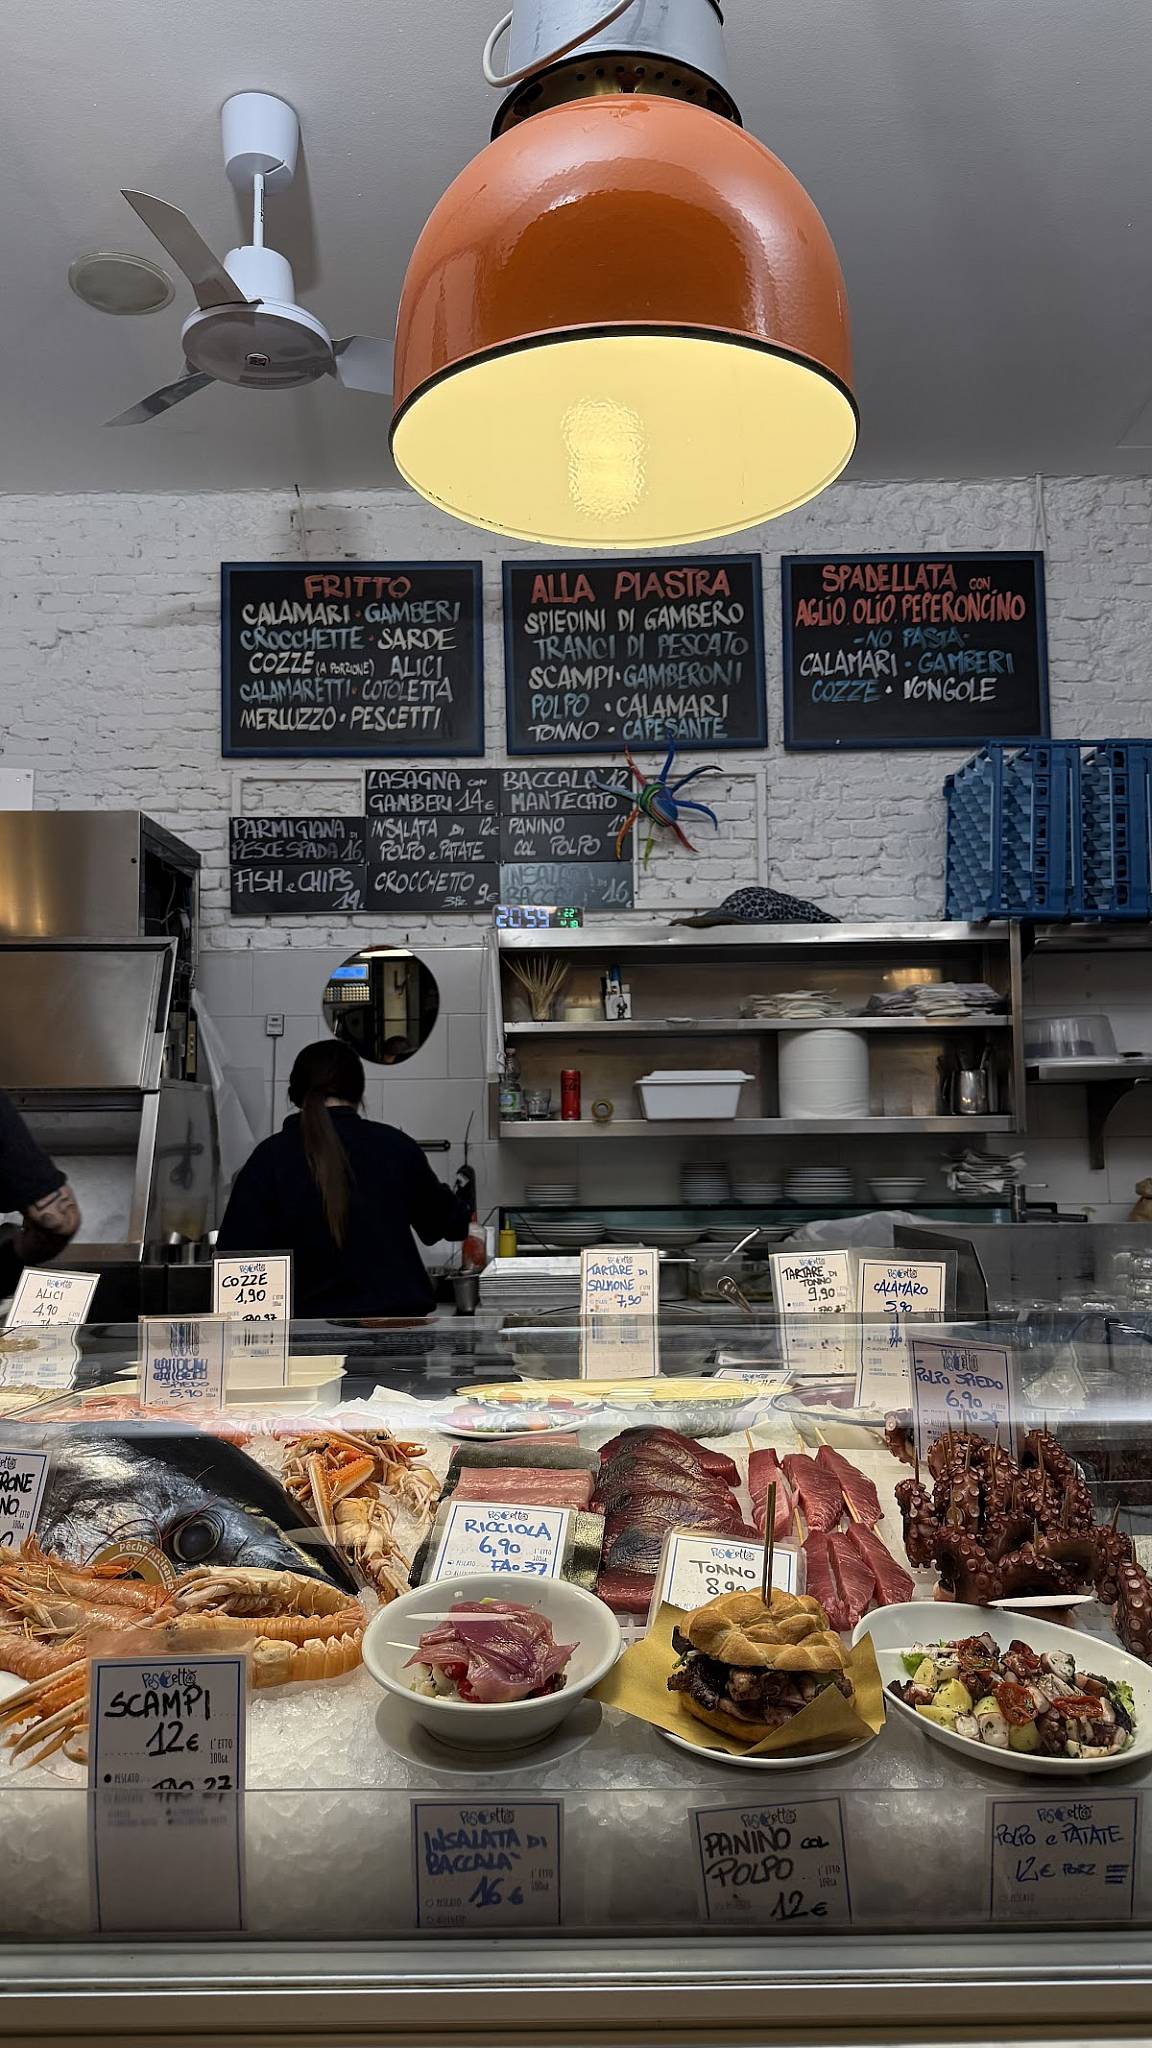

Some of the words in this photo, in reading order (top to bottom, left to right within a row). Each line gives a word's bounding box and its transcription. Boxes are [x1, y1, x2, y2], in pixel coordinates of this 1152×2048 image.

[304, 574, 412, 599] FRITTO
[531, 572, 596, 604] ALLA
[614, 568, 731, 600] PIASTRA
[822, 563, 958, 592] SPADELLATA
[969, 577, 991, 590] CON
[242, 600, 349, 626] CALAMARI
[365, 601, 460, 624] GAMBERI
[902, 589, 1025, 622] PEPERONCINO
[525, 608, 606, 635] SPIEDINI
[618, 608, 634, 631] DI
[645, 601, 744, 630] GAMBERO
[240, 626, 365, 650] CROCCHETTE
[378, 628, 456, 650] SARDE
[534, 634, 615, 661] TRANCI
[628, 633, 644, 659] DI
[658, 631, 749, 659] PESCATO
[250, 651, 315, 674] COZZE
[390, 656, 442, 677] ALICI
[800, 649, 897, 678] CALAMARI
[918, 651, 1014, 674] GAMBERI
[528, 665, 614, 690] SCAMPI
[623, 661, 741, 689] GAMBERONI
[239, 678, 350, 704] CALAMARETTI
[362, 677, 453, 702] COTOLETTA
[811, 679, 880, 704] COZZE
[903, 676, 997, 702] VONGOLE
[240, 707, 336, 731] MERLUZZO
[350, 706, 441, 731] PESCETTI
[531, 693, 590, 721] POLPO
[616, 694, 728, 719] CALAMARI
[528, 721, 599, 742] TONNO
[623, 718, 727, 740] CAPESANTE
[368, 771, 460, 790] LASAGNA
[369, 794, 452, 813] GAMBERI
[511, 792, 617, 813] MANTECATO
[232, 818, 344, 839] PARMIGIANA
[371, 817, 437, 843] INSALATA
[448, 824, 464, 836] DI
[508, 818, 565, 836] PANINO
[380, 840, 425, 861] POLPO
[439, 839, 485, 862] PATATE
[514, 841, 536, 856] COL
[551, 835, 601, 856] POLPO
[233, 869, 283, 893] FISH
[298, 868, 354, 892] CHIPS
[375, 870, 474, 893] CROCCHETTO
[222, 1273, 268, 1287] COZZE
[587, 1263, 633, 1275] TARTARE
[782, 1266, 824, 1281] TARTARE
[587, 1279, 634, 1291] SALMONE
[799, 1277, 832, 1287] TONNO
[874, 1279, 928, 1297] CALAMARO
[36, 1288, 63, 1300] ALICI
[235, 1288, 266, 1304] 1,90
[808, 1287, 835, 1302] 9,90
[915, 1367, 950, 1384] POLPO
[169, 1389, 202, 1398] 5,90
[465, 1519, 551, 1541] RICCIOLA
[119, 1542, 149, 1554] Pêche
[479, 1536, 521, 1557] 6,90
[491, 1559, 521, 1572] FAO
[521, 1561, 548, 1575] 37
[689, 1560, 756, 1579] TONNO
[104, 1685, 210, 1720] SCAMPI
[424, 1827, 521, 1853] INSALATA
[527, 1834, 547, 1848] DI
[703, 1827, 791, 1858] PANINO
[801, 1835, 829, 1849] COL
[994, 1824, 1036, 1846] POLPO
[1062, 1823, 1124, 1846] PATATE
[705, 1855, 793, 1887] POLPO
